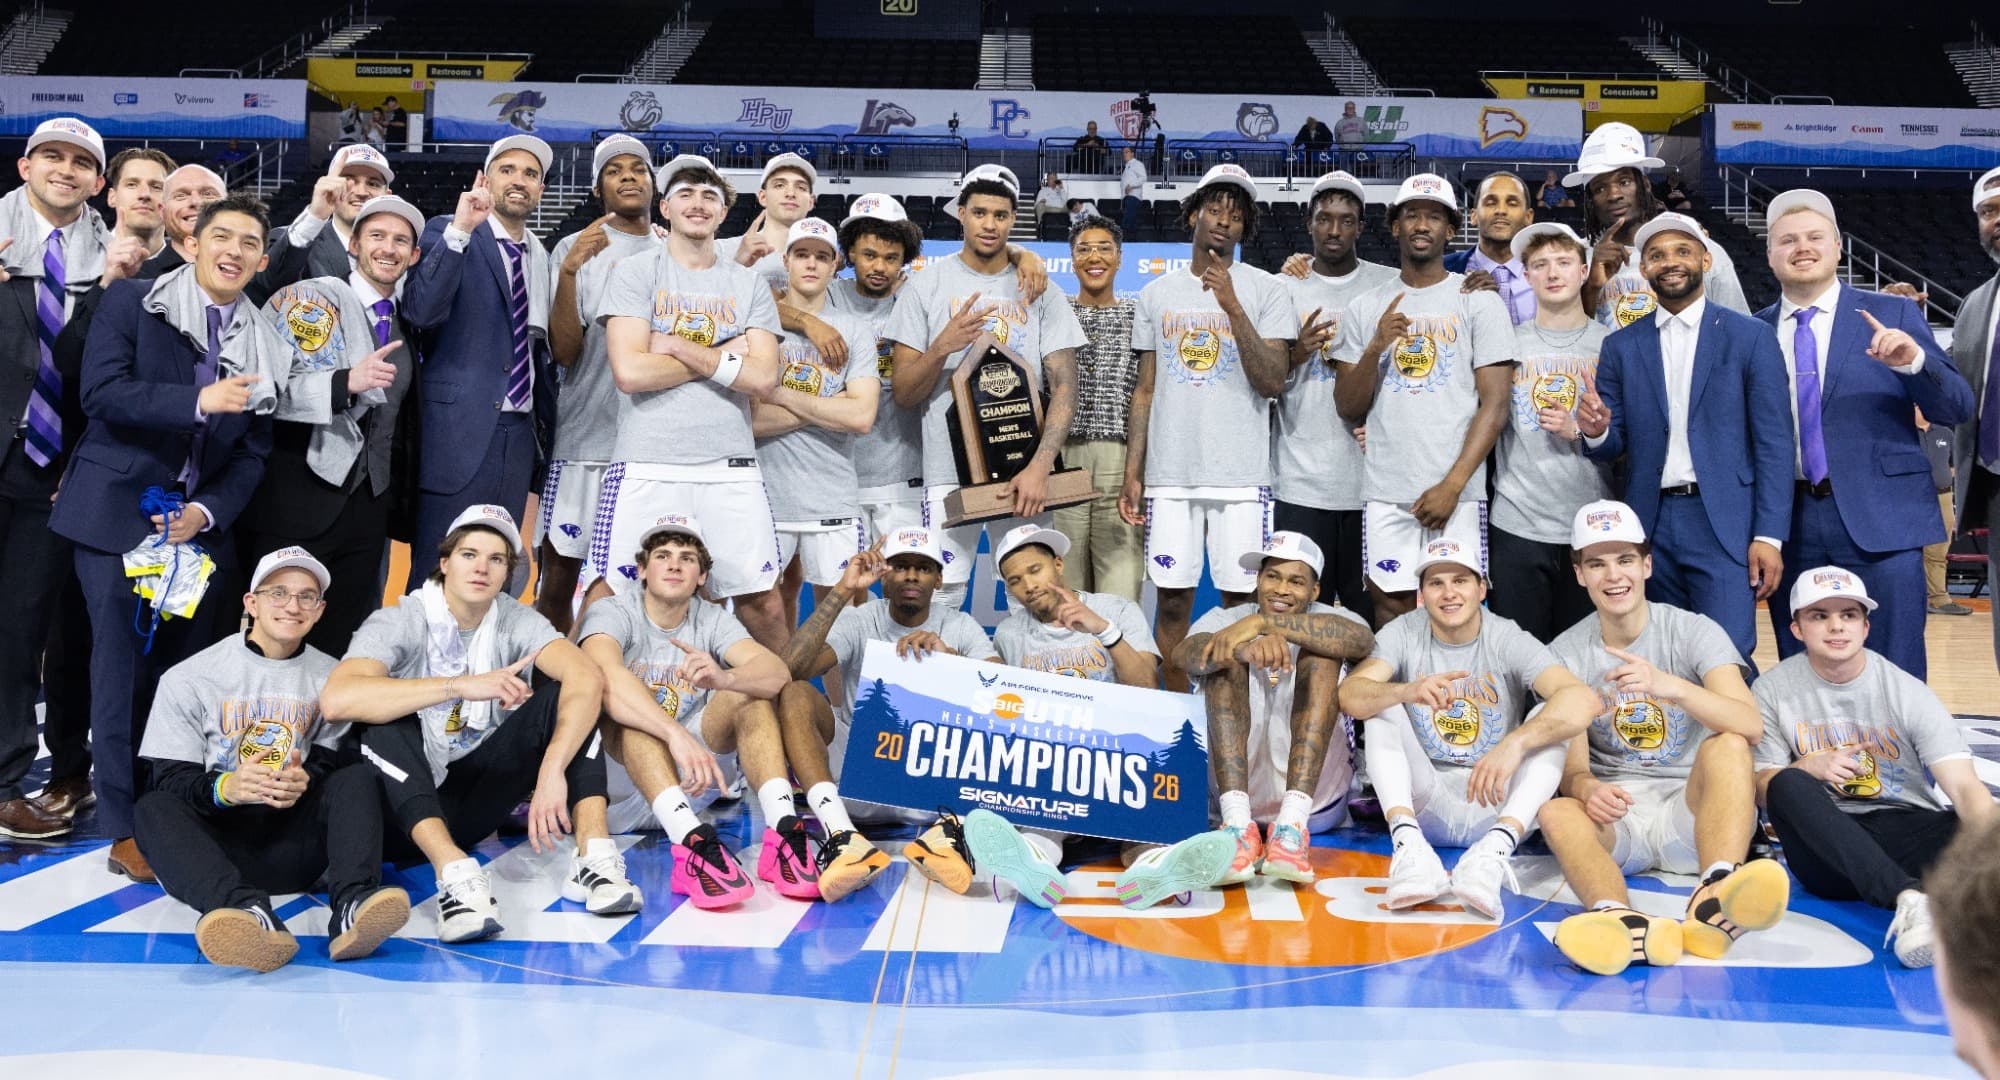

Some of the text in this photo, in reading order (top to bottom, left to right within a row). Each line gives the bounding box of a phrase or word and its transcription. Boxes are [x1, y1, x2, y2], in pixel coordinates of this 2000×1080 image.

[885, 0, 913, 12] 20
[357, 66, 403, 75] CONCESSIONS
[431, 67, 472, 76] Restrooms
[31, 92, 66, 103] FREEDOM
[1539, 86, 1580, 96] Restrooms
[1602, 87, 1649, 97] Concessions
[187, 96, 215, 105] vivenu
[736, 97, 792, 133] HPU
[1795, 123, 1837, 133] BrightRidge
[1851, 124, 1884, 134] Canon
[1900, 123, 1939, 134] TENNESSEE
[653, 289, 737, 325] CHAMPIONS
[290, 319, 322, 338] 2026
[1182, 346, 1212, 358] 2026
[1397, 353, 1429, 366] 2026
[980, 403, 1031, 418] CHAMPION
[998, 423, 1019, 433] MEN'S
[988, 431, 1033, 444] BASKETBALL
[1018, 684, 1048, 694] FORCE
[1051, 689, 1095, 702] RESERVE
[941, 710, 1121, 750] MEN'S BASKETBALL
[1437, 717, 1472, 731] 2026
[1620, 723, 1658, 735] 2026
[874, 731, 905, 761] 20
[905, 720, 1148, 810] CHAMPIONS
[1152, 772, 1180, 802] 26
[958, 786, 1090, 818] SIGNATURE
[978, 802, 1069, 821] CHAMPIONSHIP RINGS
